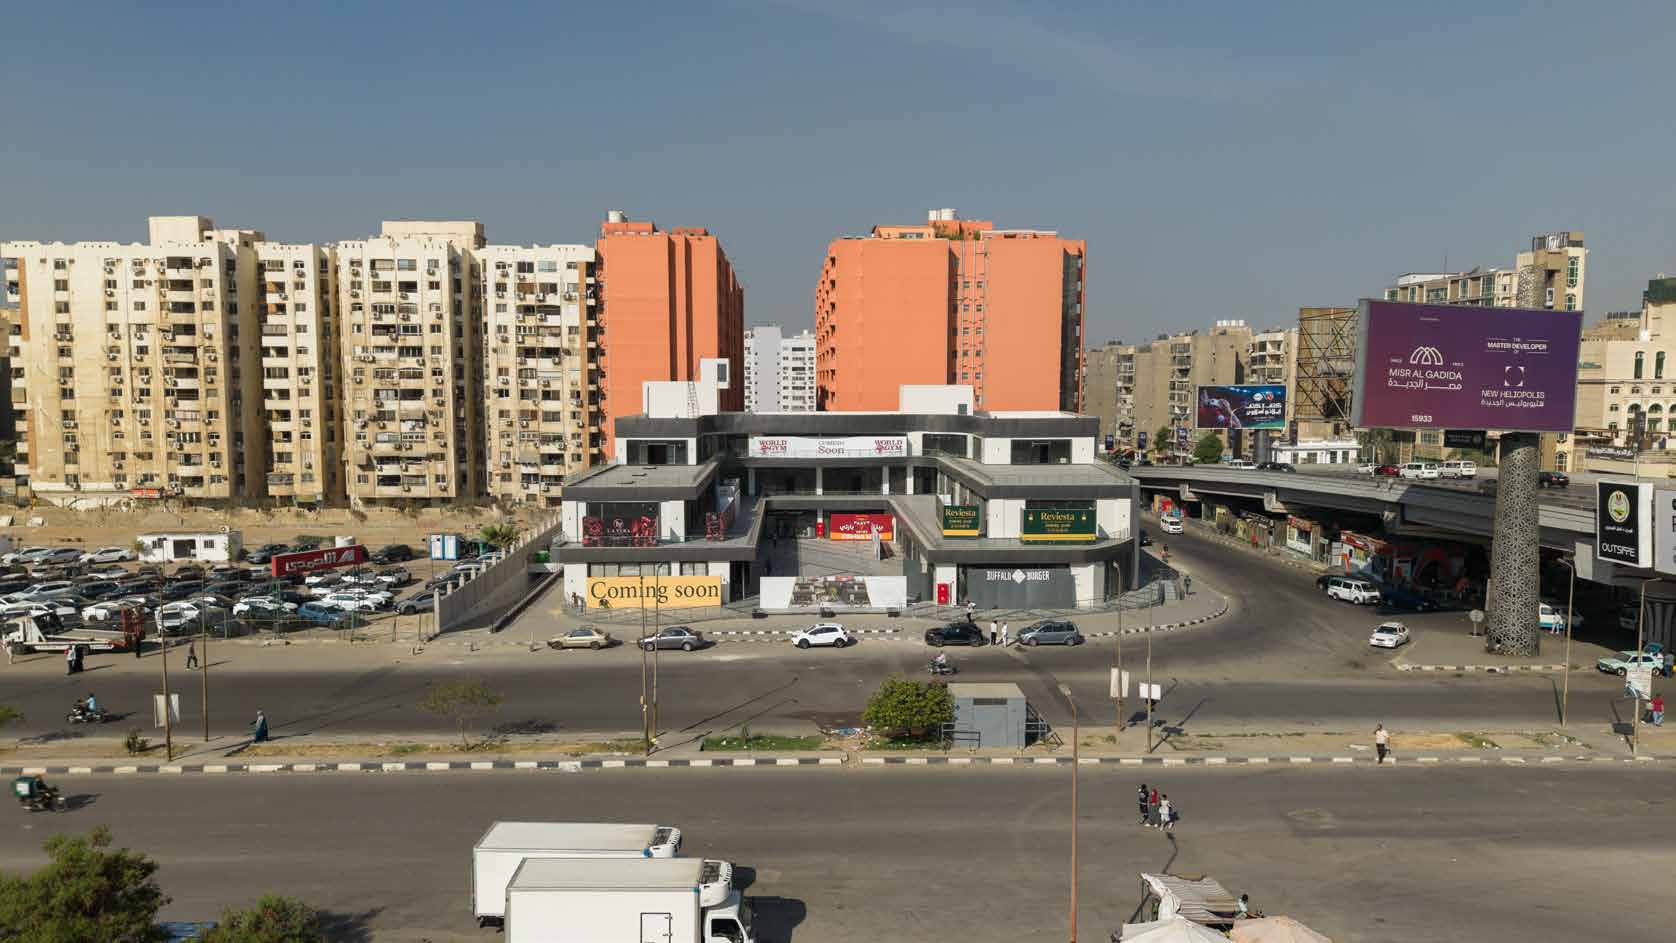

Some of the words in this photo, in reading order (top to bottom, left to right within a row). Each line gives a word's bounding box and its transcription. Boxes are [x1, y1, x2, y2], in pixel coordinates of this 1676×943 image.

[1389, 368, 1411, 377] MISR
[1412, 370, 1424, 378] AL
[1425, 370, 1463, 380] GADIDA
[1388, 378, 1424, 389] الجديدة
[1424, 382, 1463, 390] مصر
[1500, 391, 1545, 399] HELIOPOLIS
[1411, 415, 1433, 423] 15933
[818, 446, 845, 454] Soon
[945, 508, 977, 517] Reviesta
[1040, 512, 1075, 521] Reviesta
[986, 570, 1012, 581] BUFFALO
[1026, 570, 1050, 581] BURGER
[590, 581, 669, 604] Coming
[674, 584, 719, 598] soon
